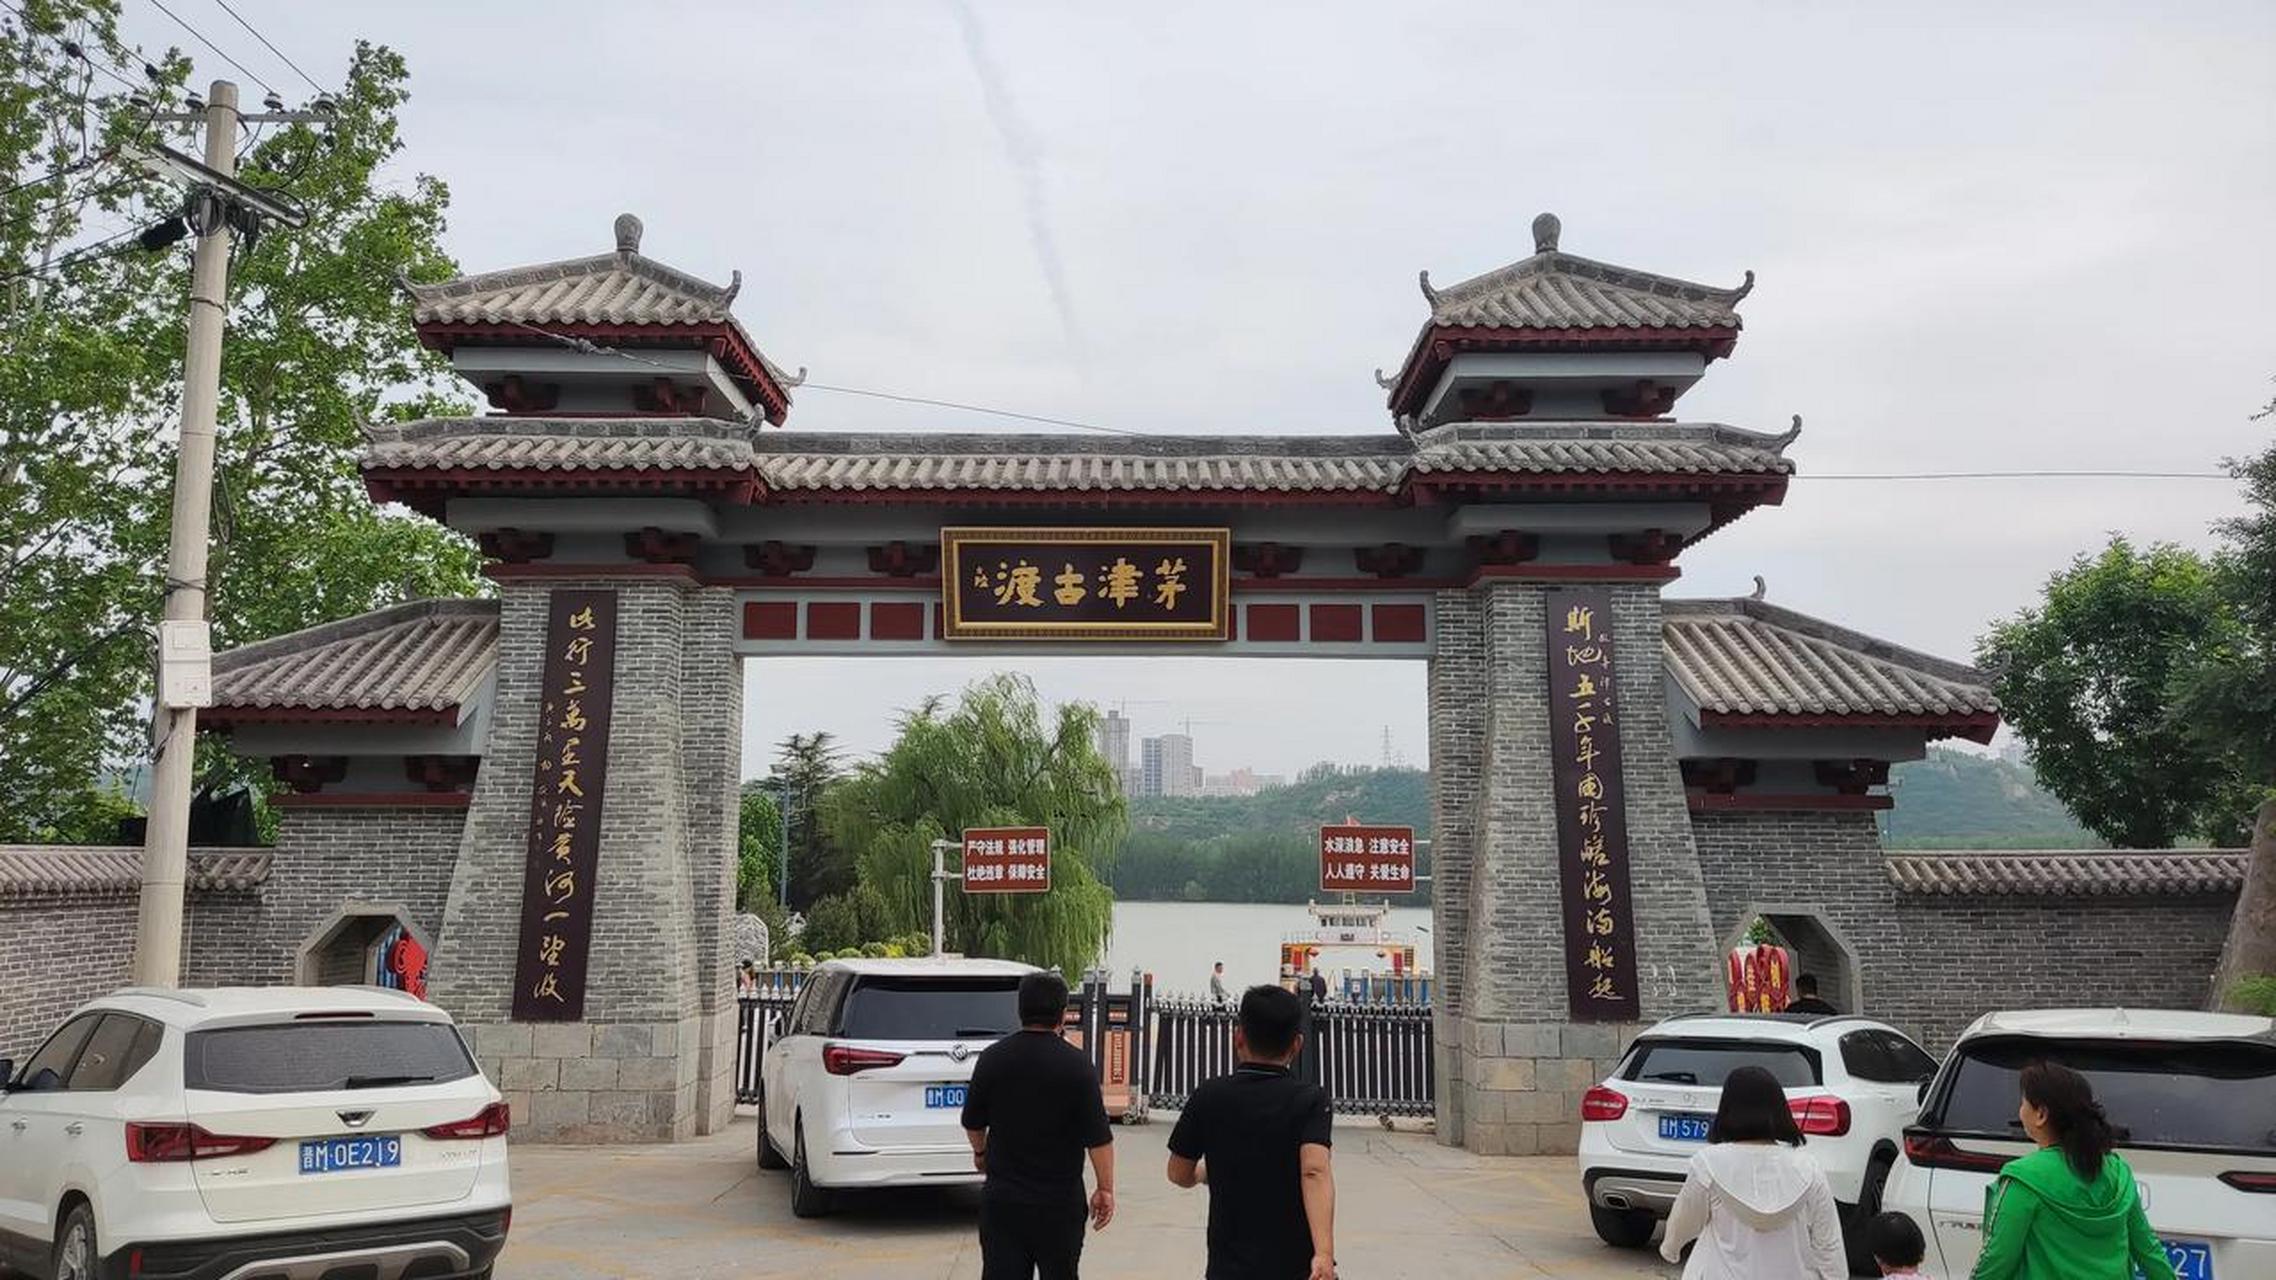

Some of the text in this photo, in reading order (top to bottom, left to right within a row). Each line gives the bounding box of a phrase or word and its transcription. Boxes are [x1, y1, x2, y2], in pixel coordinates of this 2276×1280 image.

[994, 558, 1187, 610] 茅津古渡
[1369, 836, 1410, 855] 注意安全
[1008, 864, 1046, 881] 保障安全
[1324, 862, 1411, 880] 人人遵守 关爱生命
